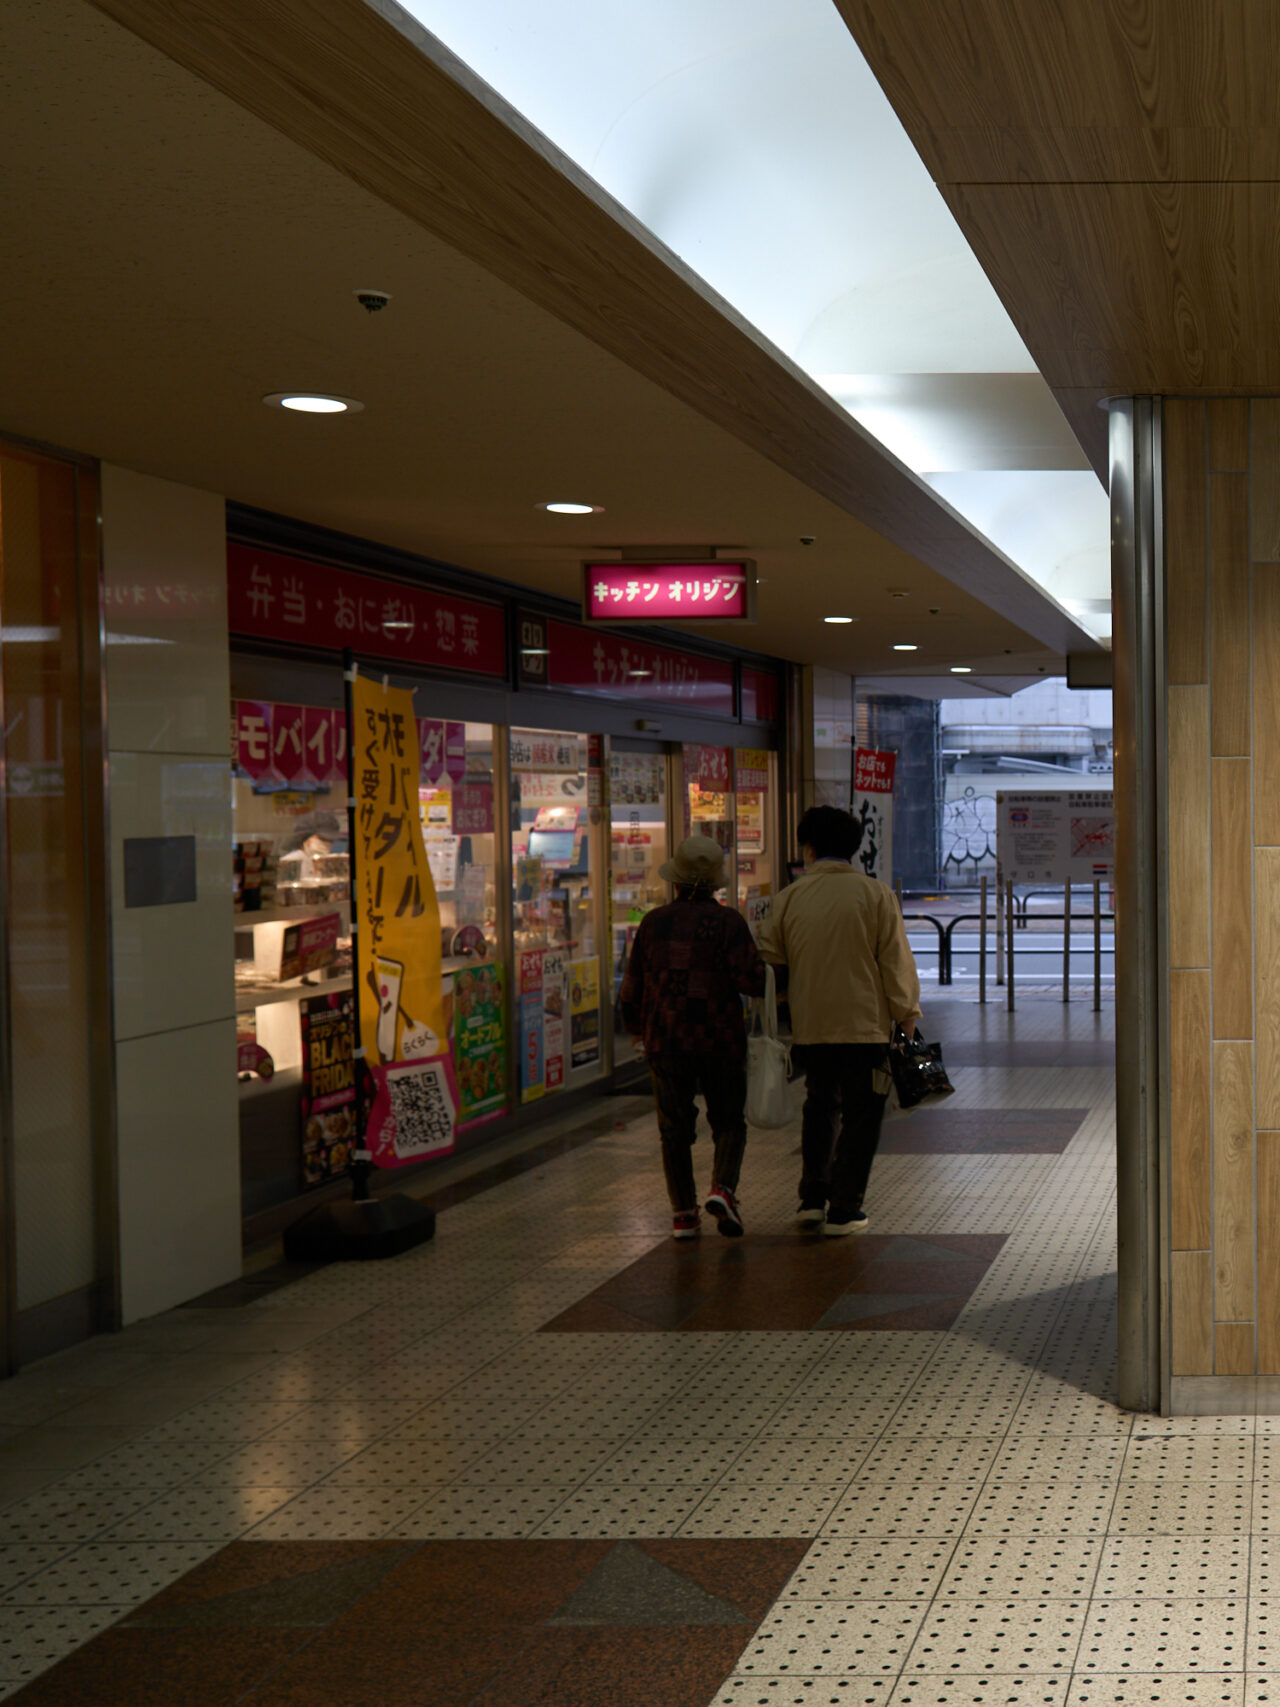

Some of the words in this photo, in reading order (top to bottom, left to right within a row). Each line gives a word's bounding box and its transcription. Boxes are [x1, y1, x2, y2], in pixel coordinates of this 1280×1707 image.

[594, 581, 660, 602] キッチン
[668, 580, 739, 602] オリジン
[700, 749, 730, 780] おせち
[402, 1030, 435, 1056] らくらく
[311, 1061, 356, 1099] FRIDA
